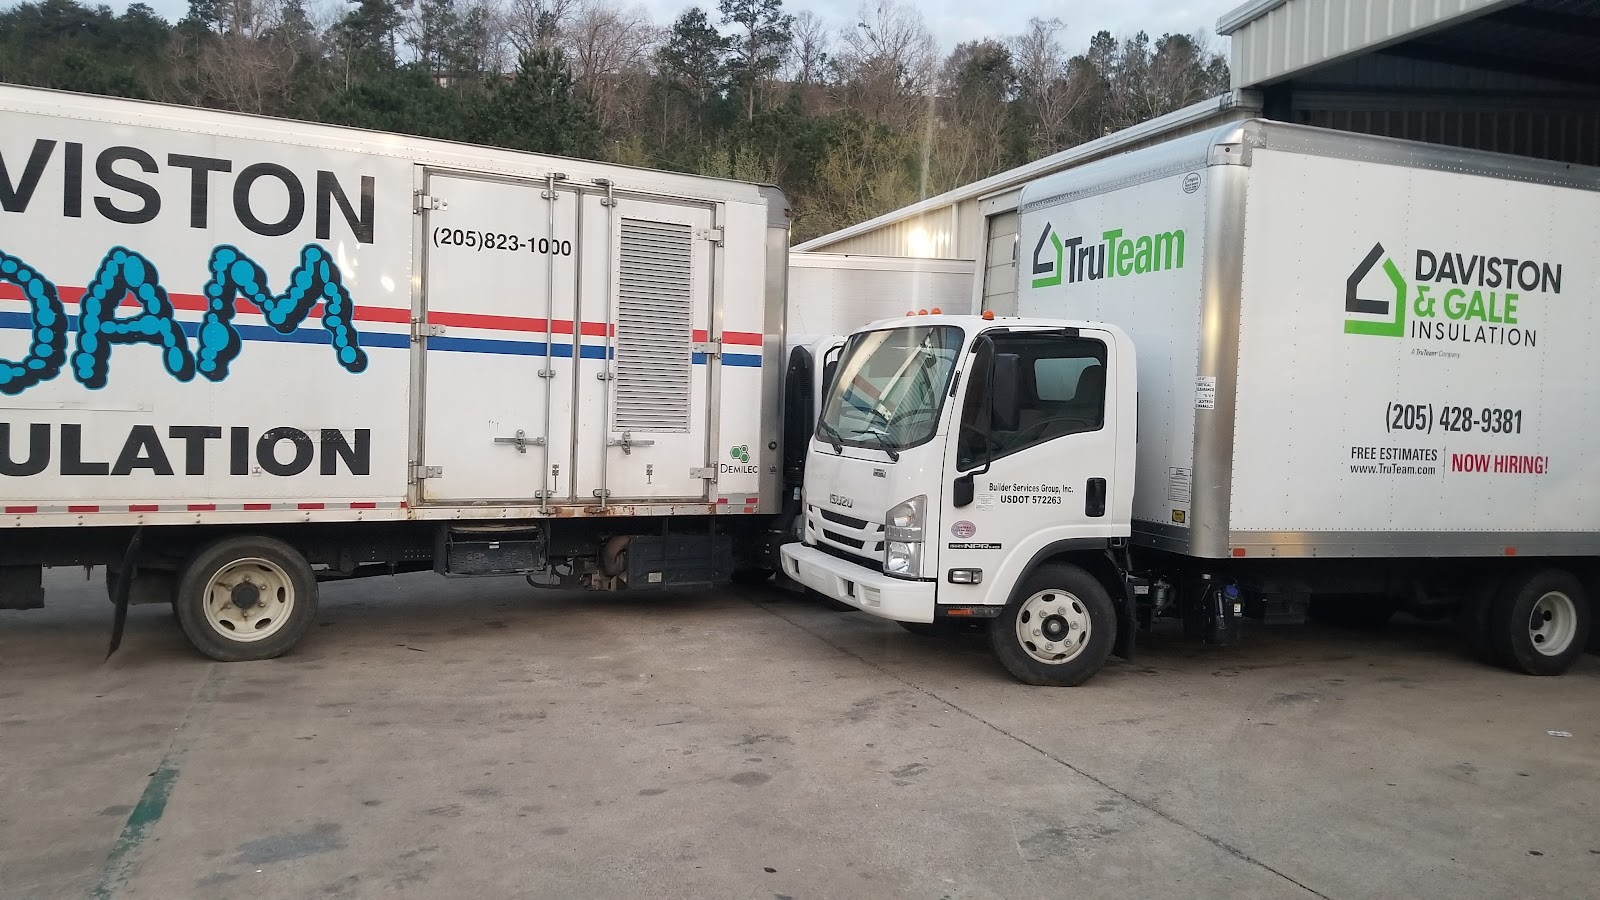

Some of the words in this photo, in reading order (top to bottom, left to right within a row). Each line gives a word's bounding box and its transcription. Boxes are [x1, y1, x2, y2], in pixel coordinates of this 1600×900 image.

[0, 138, 375, 244] VISTON
[433, 227, 572, 256] (205)823-1000
[1065, 228, 1185, 284] TruTeam
[1415, 249, 1562, 294] DAVISTON
[1413, 285, 1436, 318] &
[1443, 288, 1519, 324] GALE
[1411, 320, 1537, 347] INSULATION
[1385, 402, 1433, 435] (205)
[1439, 406, 1522, 434] 428-9381
[0, 422, 371, 477] ULATION
[1351, 447, 1376, 460] FREE
[1379, 448, 1438, 461] ESTIMATES
[1451, 453, 1491, 473] NOW
[1494, 455, 1548, 475] HIRING!
[1350, 463, 1436, 475] www.TruTeam.com
[989, 482, 1011, 492] Builder
[1012, 483, 1039, 493] Services
[1041, 484, 1060, 494] Group,
[1062, 484, 1074, 493] Inc.
[1000, 495, 1030, 504] USDOT
[1032, 496, 1062, 505] 572263
